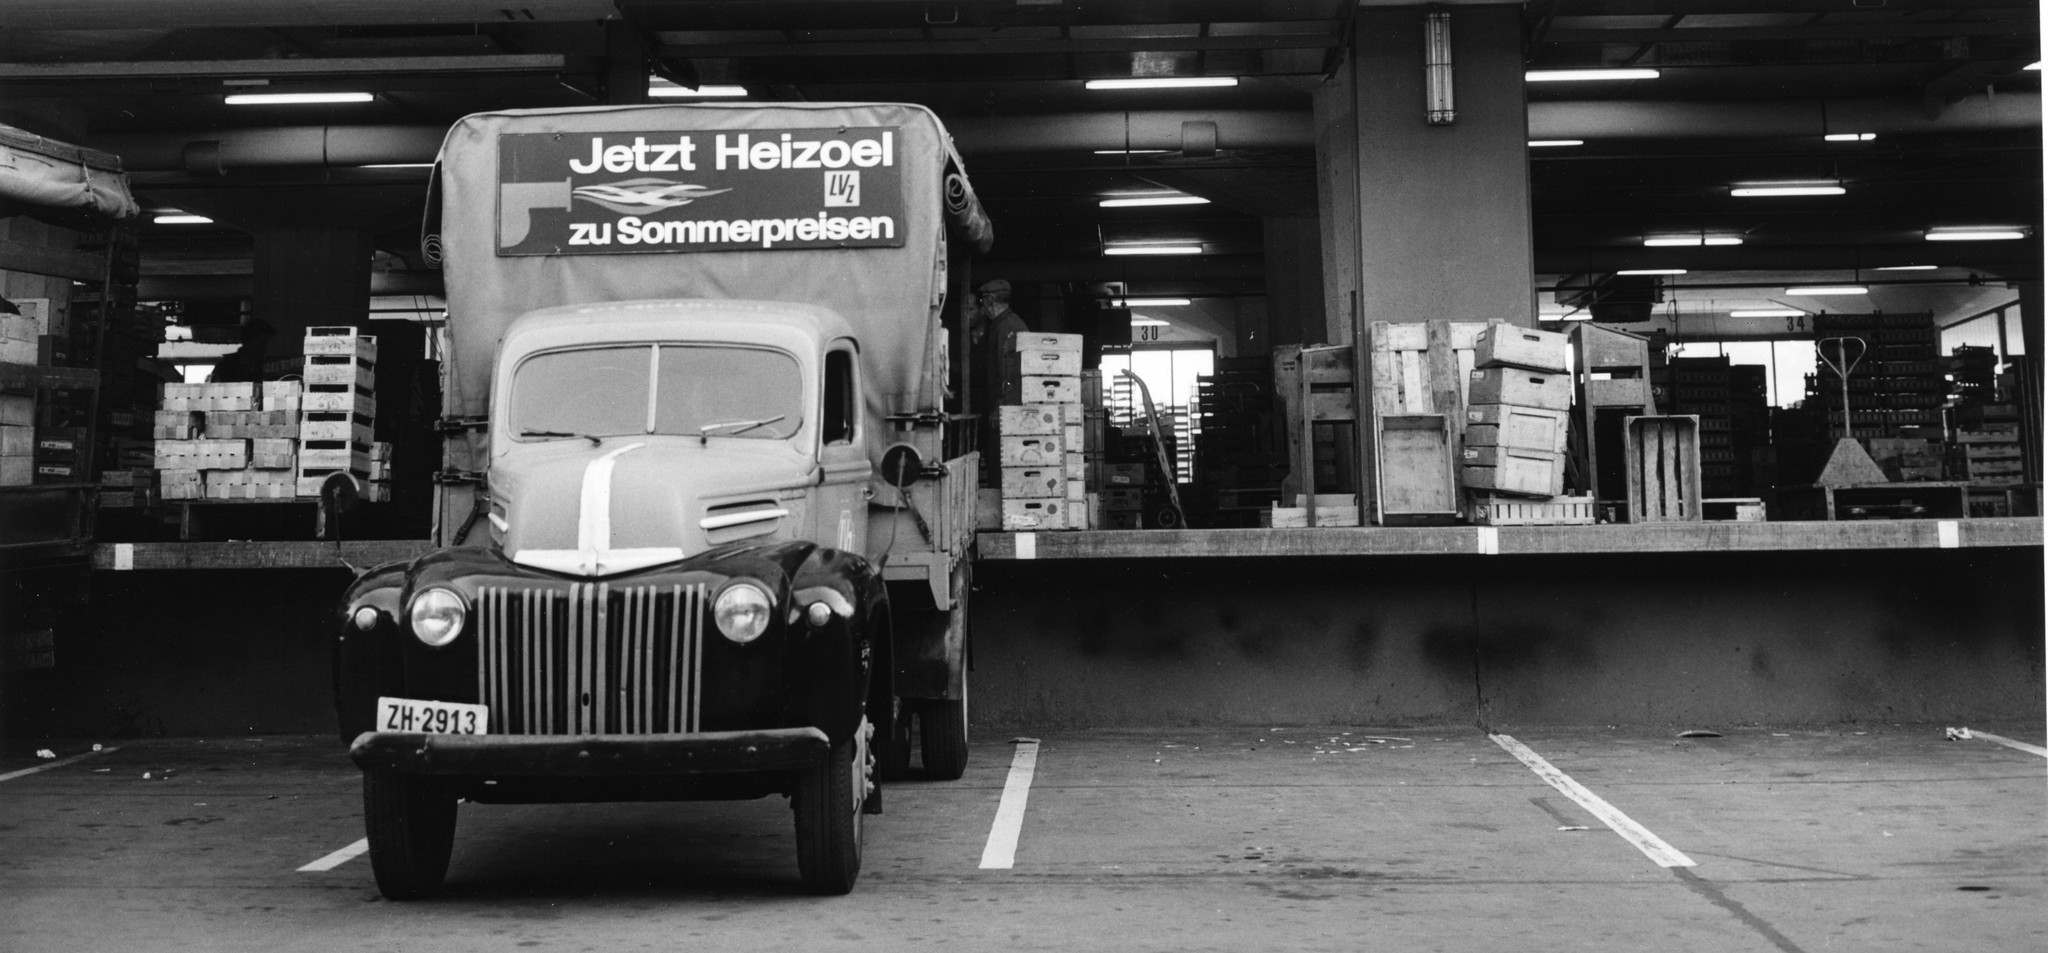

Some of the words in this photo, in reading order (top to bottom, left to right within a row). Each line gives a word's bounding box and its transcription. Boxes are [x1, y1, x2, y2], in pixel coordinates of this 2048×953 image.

[569, 135, 696, 174] Jetzt
[715, 132, 893, 170] Heizoel
[568, 222, 612, 245] zu
[616, 211, 894, 248] Sommerpreisen
[1141, 325, 1158, 341] 30
[1786, 315, 1805, 331] 34
